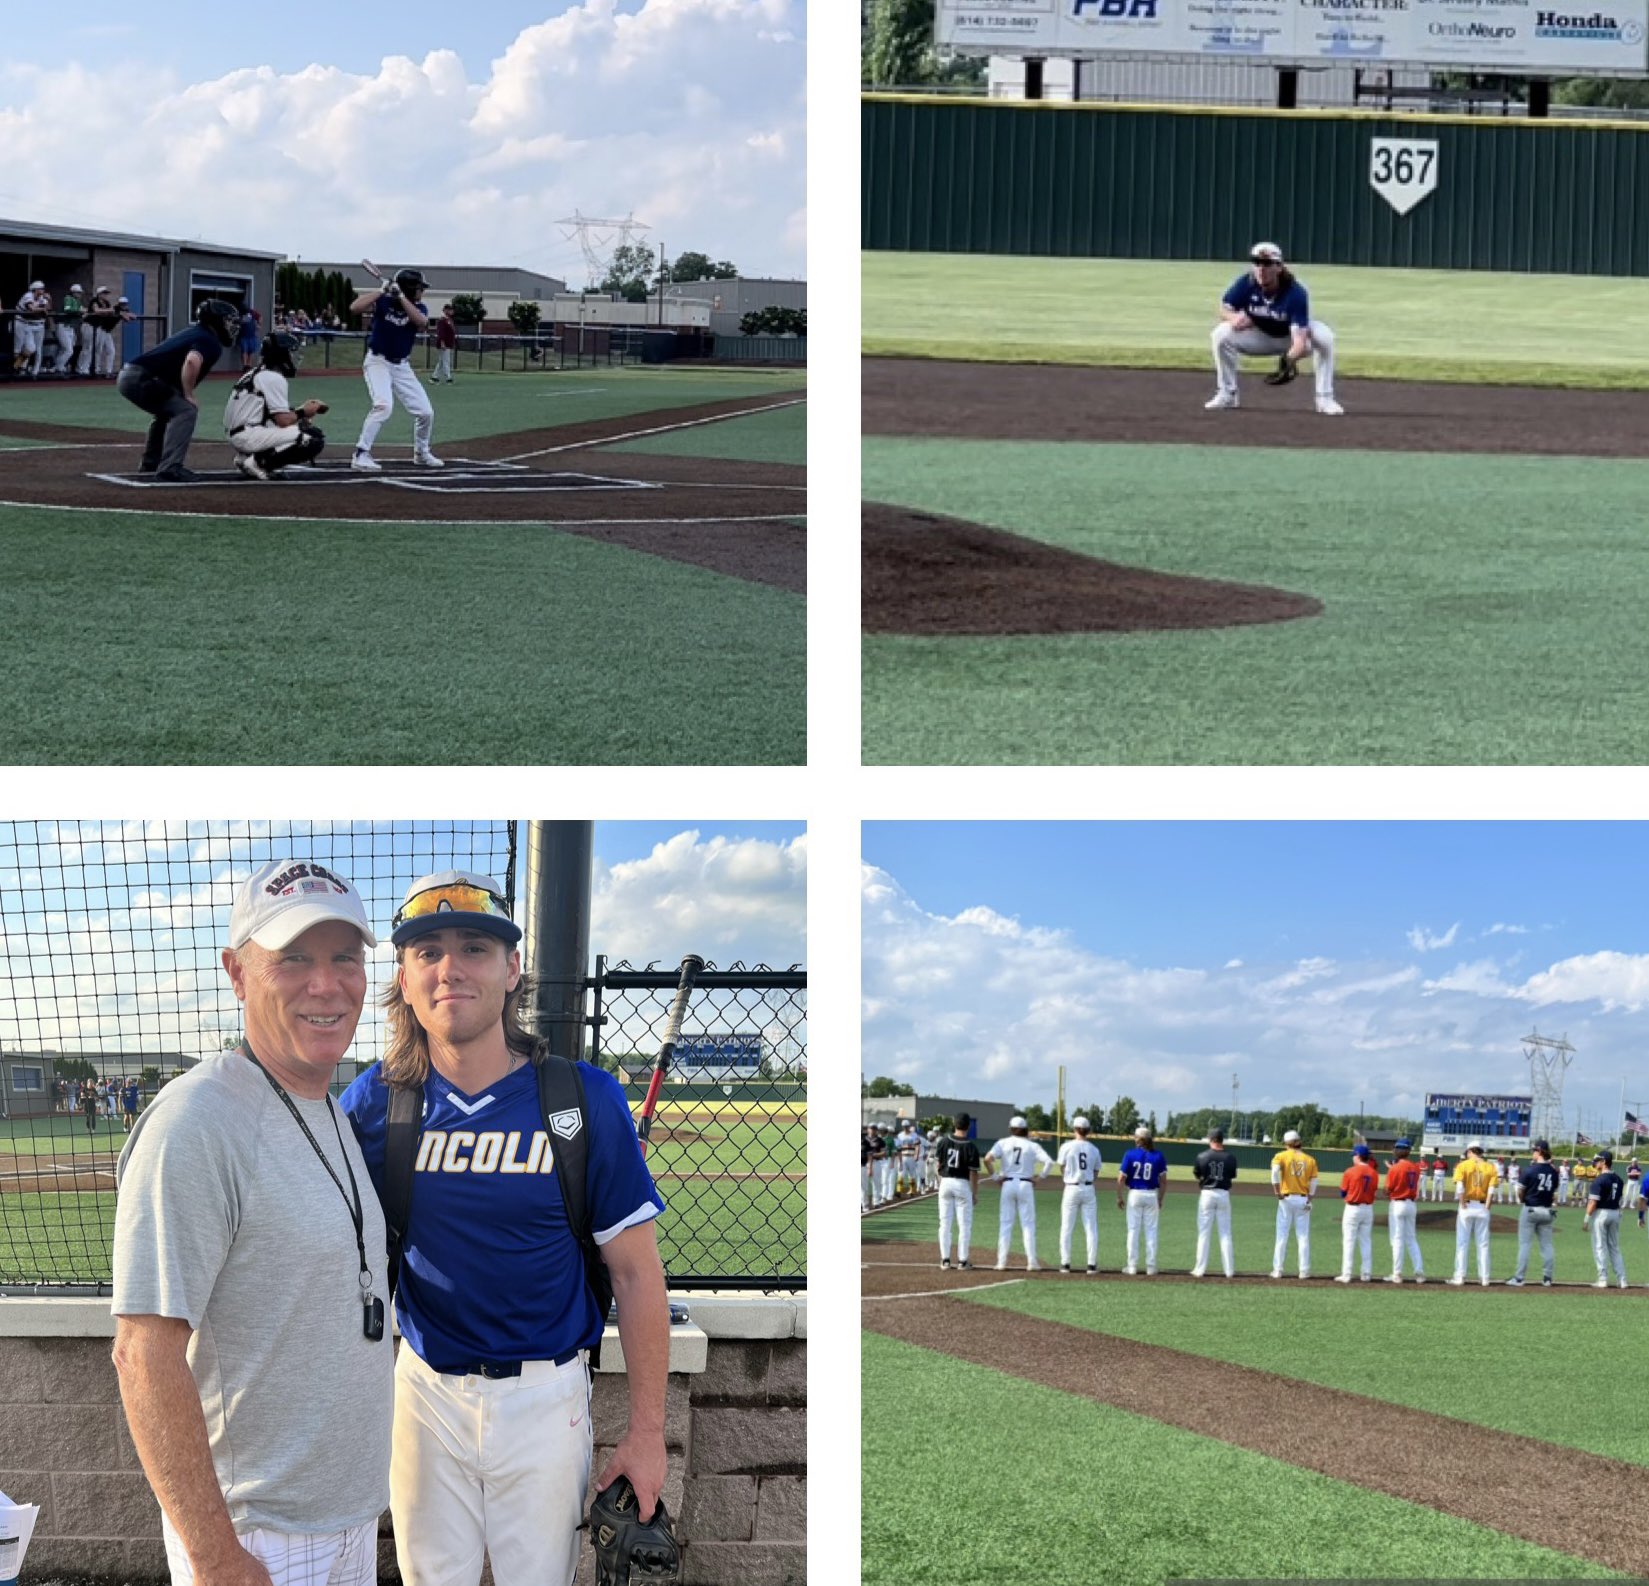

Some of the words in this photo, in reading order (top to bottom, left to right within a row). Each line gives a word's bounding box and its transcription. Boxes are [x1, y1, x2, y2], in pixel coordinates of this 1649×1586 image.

[1536, 10, 1617, 29] Honda
[1428, 22, 1516, 38] OrthoNeuro
[1373, 147, 1435, 185] 367
[265, 863, 310, 896] SPACE
[1478, 1098, 1532, 1110] PATRIOTS
[415, 1130, 555, 1174] NCOLN
[947, 1149, 960, 1168] 21
[1013, 1147, 1022, 1165] 7
[1078, 1152, 1087, 1170] 6
[1132, 1161, 1152, 1180] 28
[1208, 1160, 1225, 1180] 11
[1537, 1173, 1552, 1191] 24
